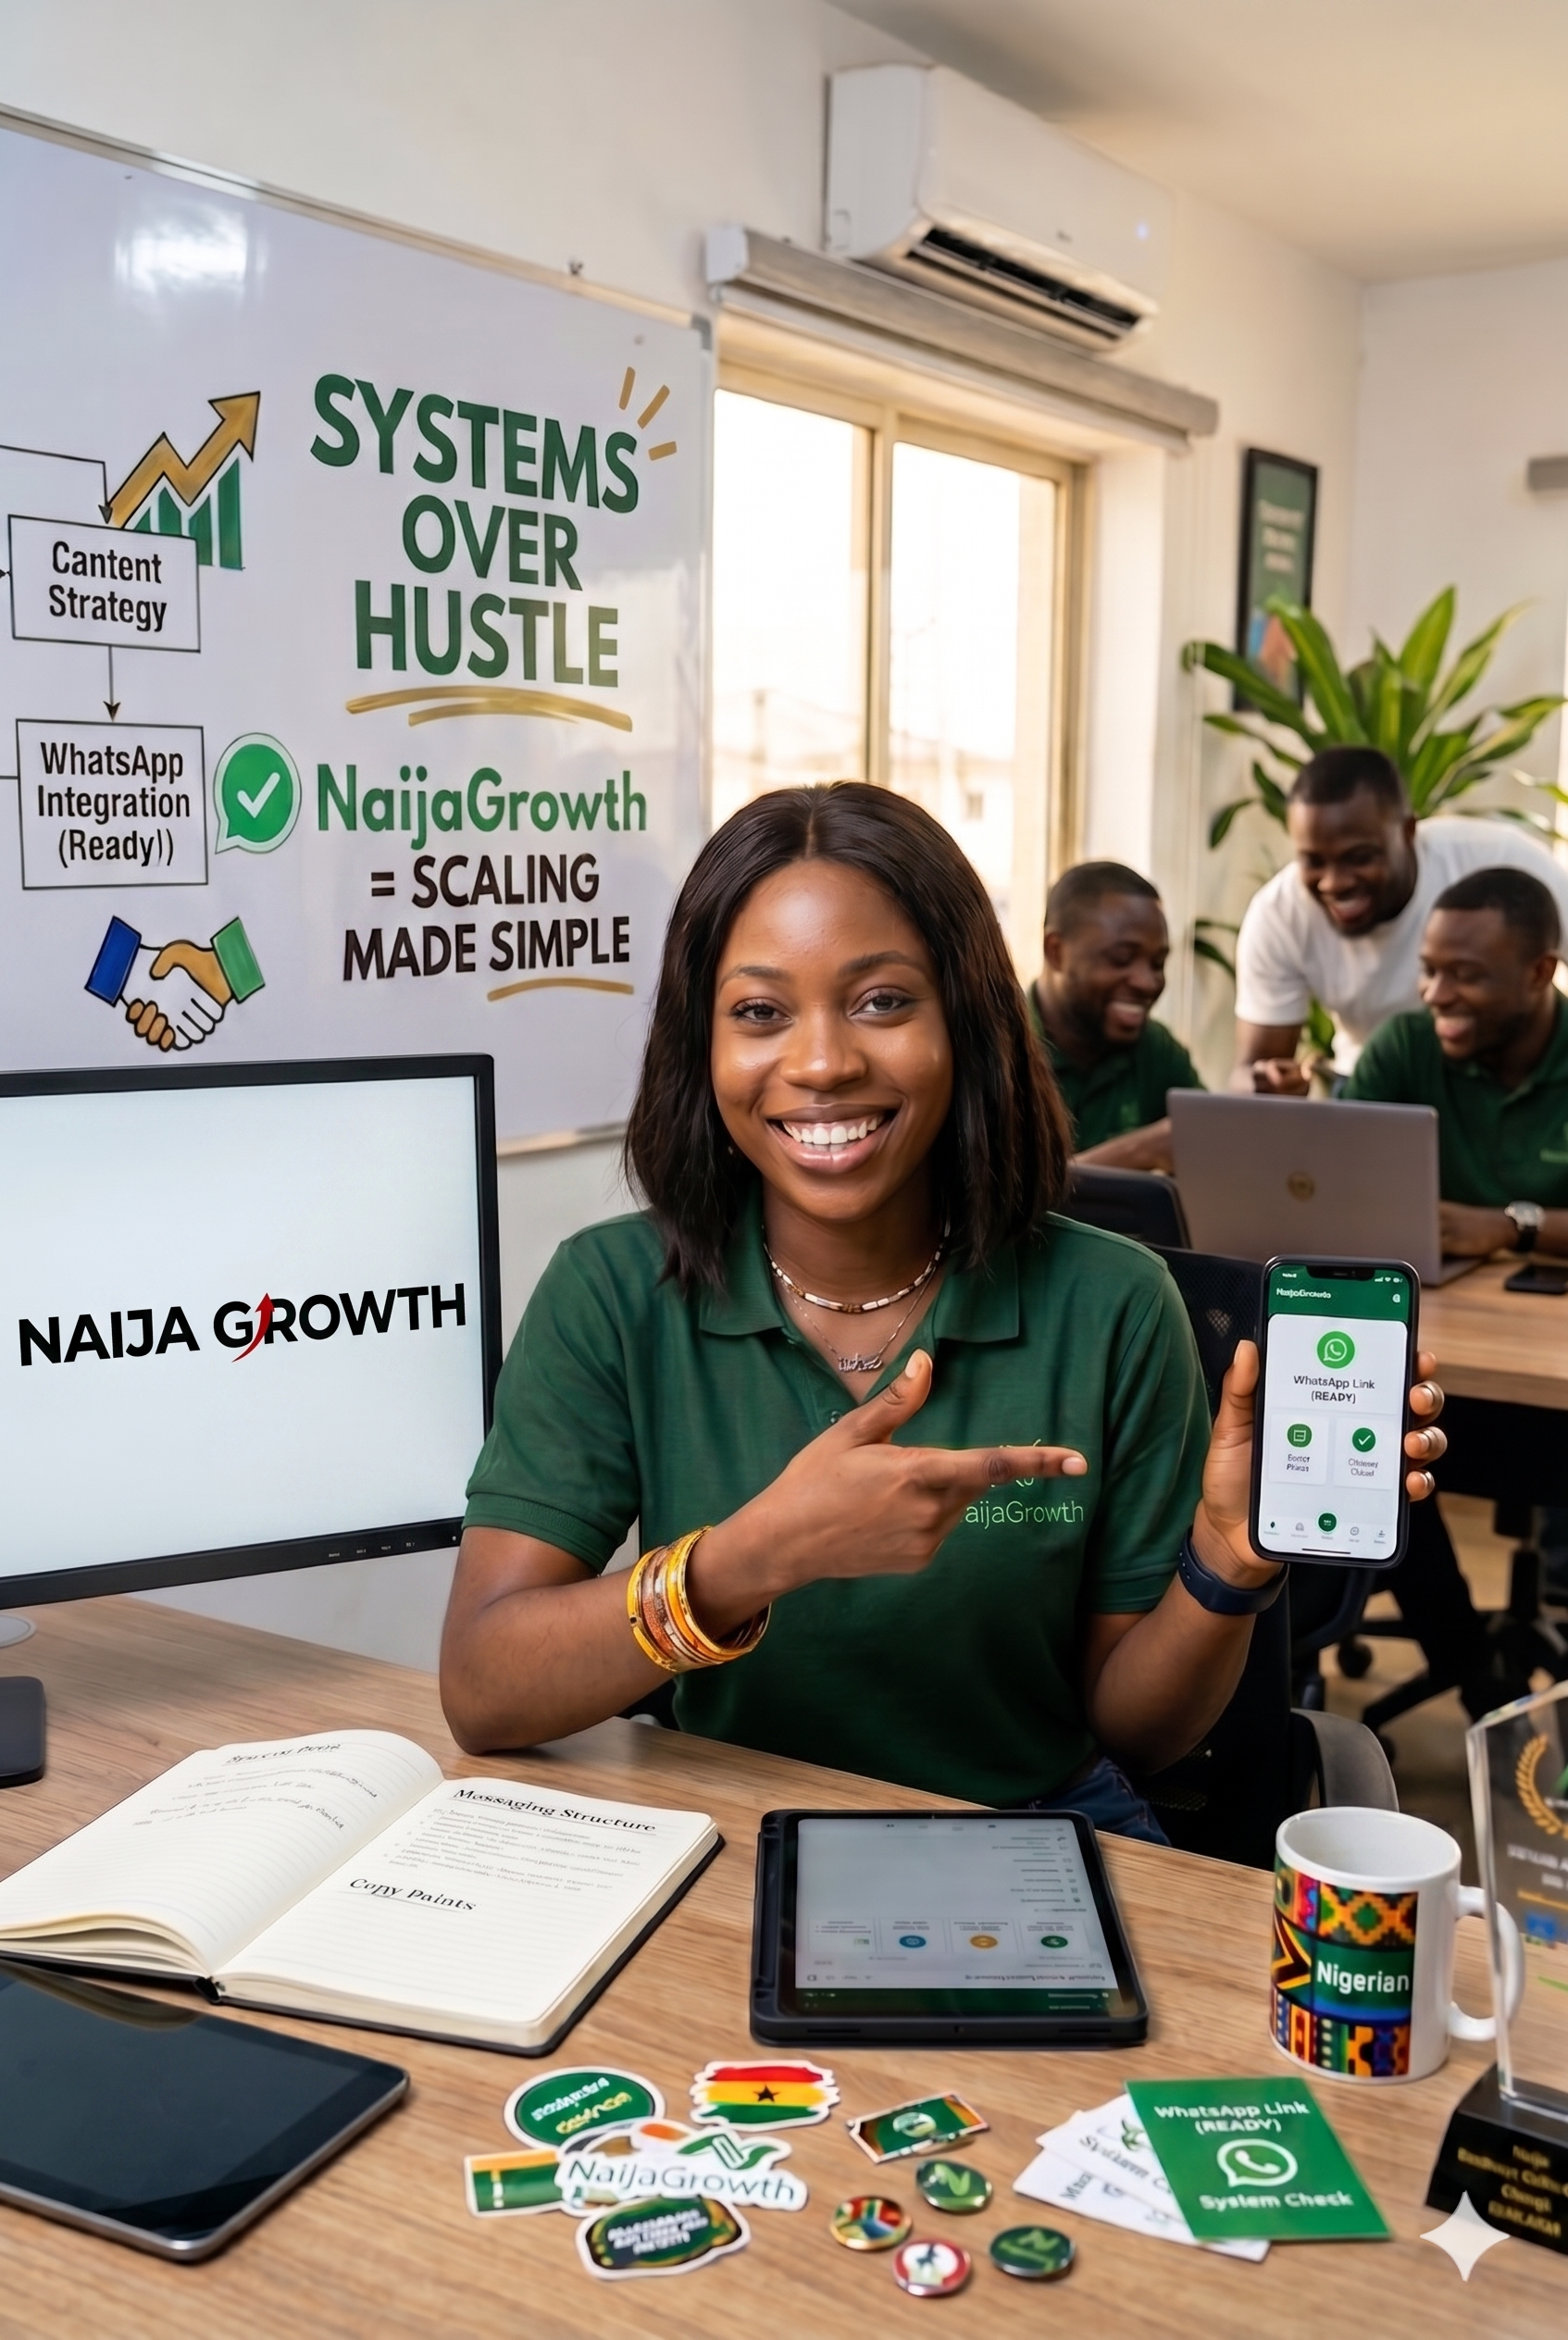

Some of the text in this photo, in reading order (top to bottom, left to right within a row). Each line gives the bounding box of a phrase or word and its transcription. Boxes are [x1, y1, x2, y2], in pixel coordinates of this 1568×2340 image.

[310, 374, 640, 513] SYSTEMS
[52, 541, 162, 584] Cantent
[402, 495, 582, 591] OVER
[49, 584, 168, 632] Strategy
[355, 580, 619, 688] HUSTLE
[40, 741, 184, 784] WhatsApp
[38, 785, 191, 824] Integration
[317, 764, 647, 850] NaijaGrowth
[412, 853, 600, 909] SCALING
[343, 916, 630, 981] MADE SIMPLE
[19, 1283, 467, 1366] NAIJA GROWTH
[1293, 1375, 1375, 1389] WhatsApp Link
[1311, 1390, 1357, 1404] (READY)
[964, 1500, 1084, 1529] aijaGrowth
[560, 1809, 657, 1832] Structure
[1316, 1960, 1410, 1995] Nigerian
[1154, 2100, 1310, 2119] WhatsApp Link
[1195, 2119, 1282, 2135] (READY)
[1284, 2190, 1354, 2208] Check
